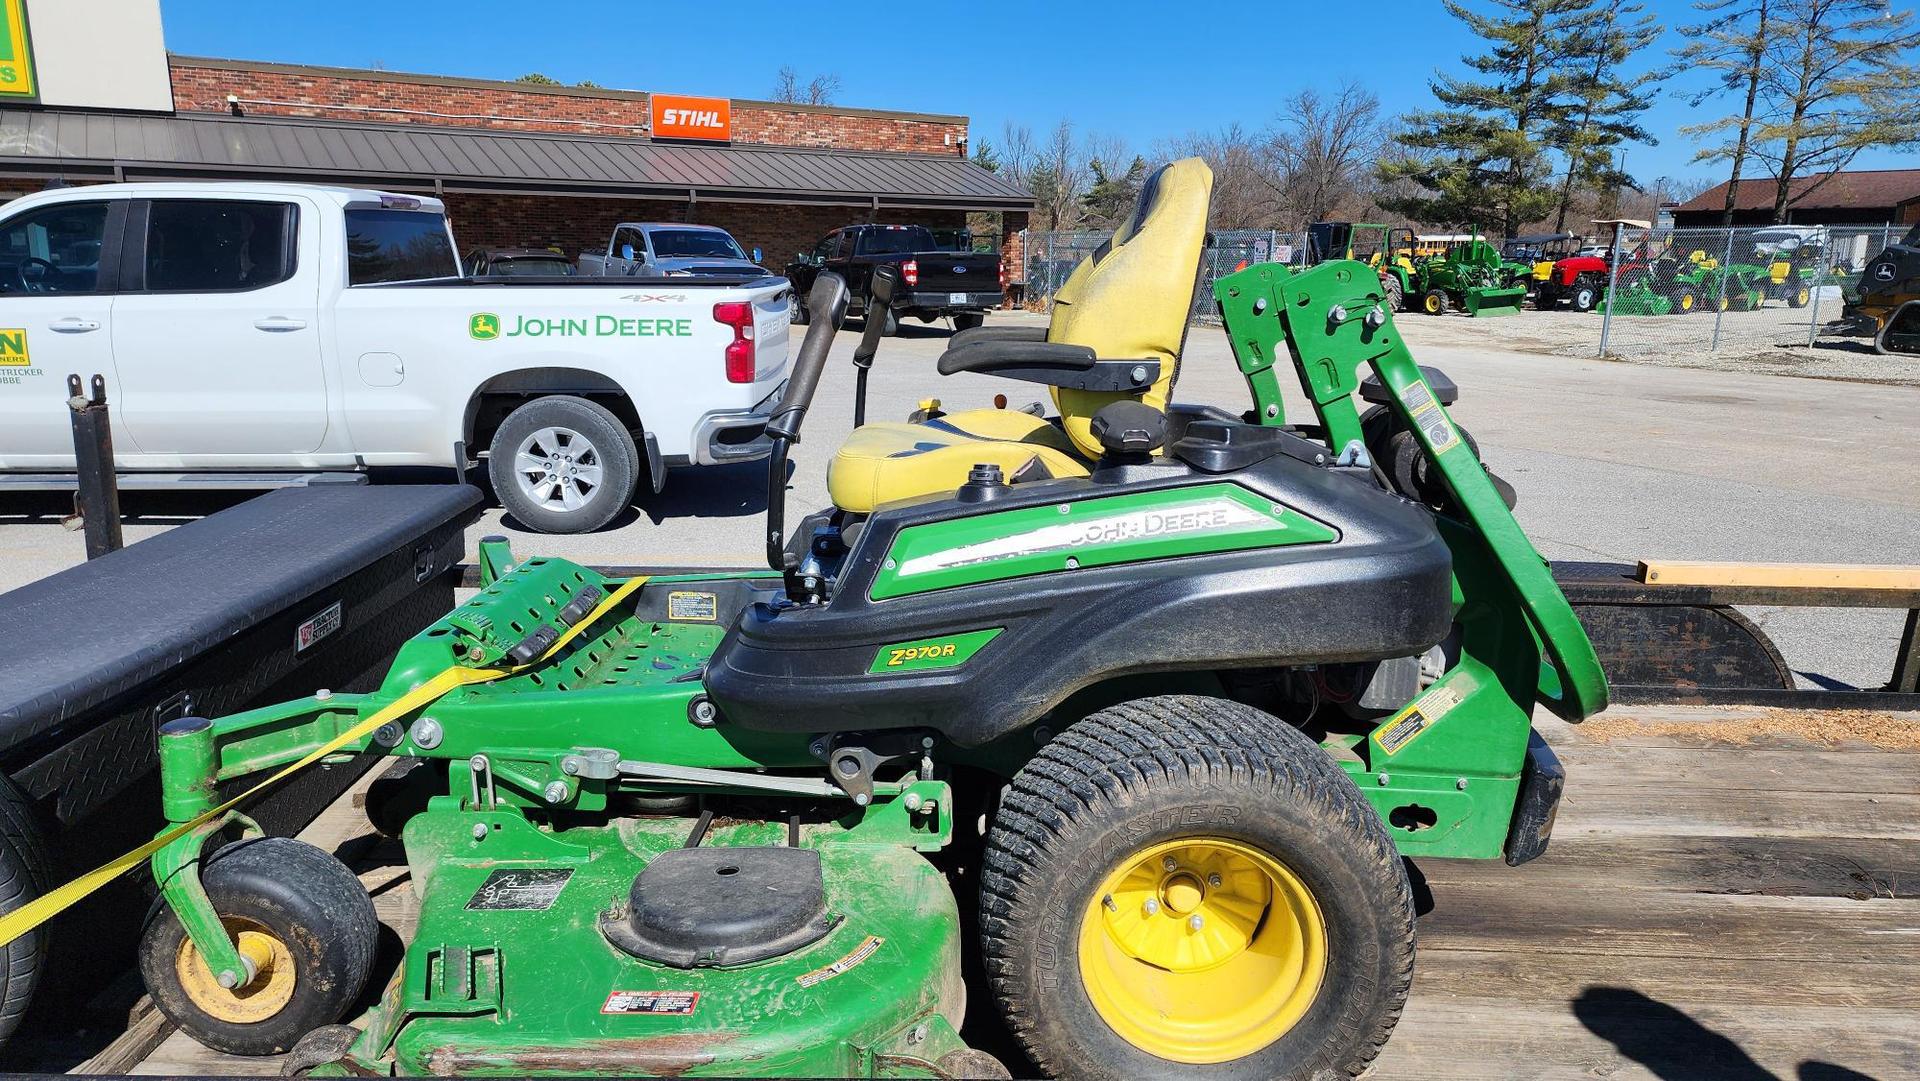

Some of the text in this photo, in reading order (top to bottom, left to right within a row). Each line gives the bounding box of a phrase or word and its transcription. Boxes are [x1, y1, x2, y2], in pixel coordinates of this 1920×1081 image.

[662, 108, 724, 128] STIHL
[506, 315, 692, 337] JOHN DEERE
[1145, 509, 1228, 534] DEERE
[887, 644, 957, 667] Z970R
[1035, 804, 1241, 995] TURF MASTER
